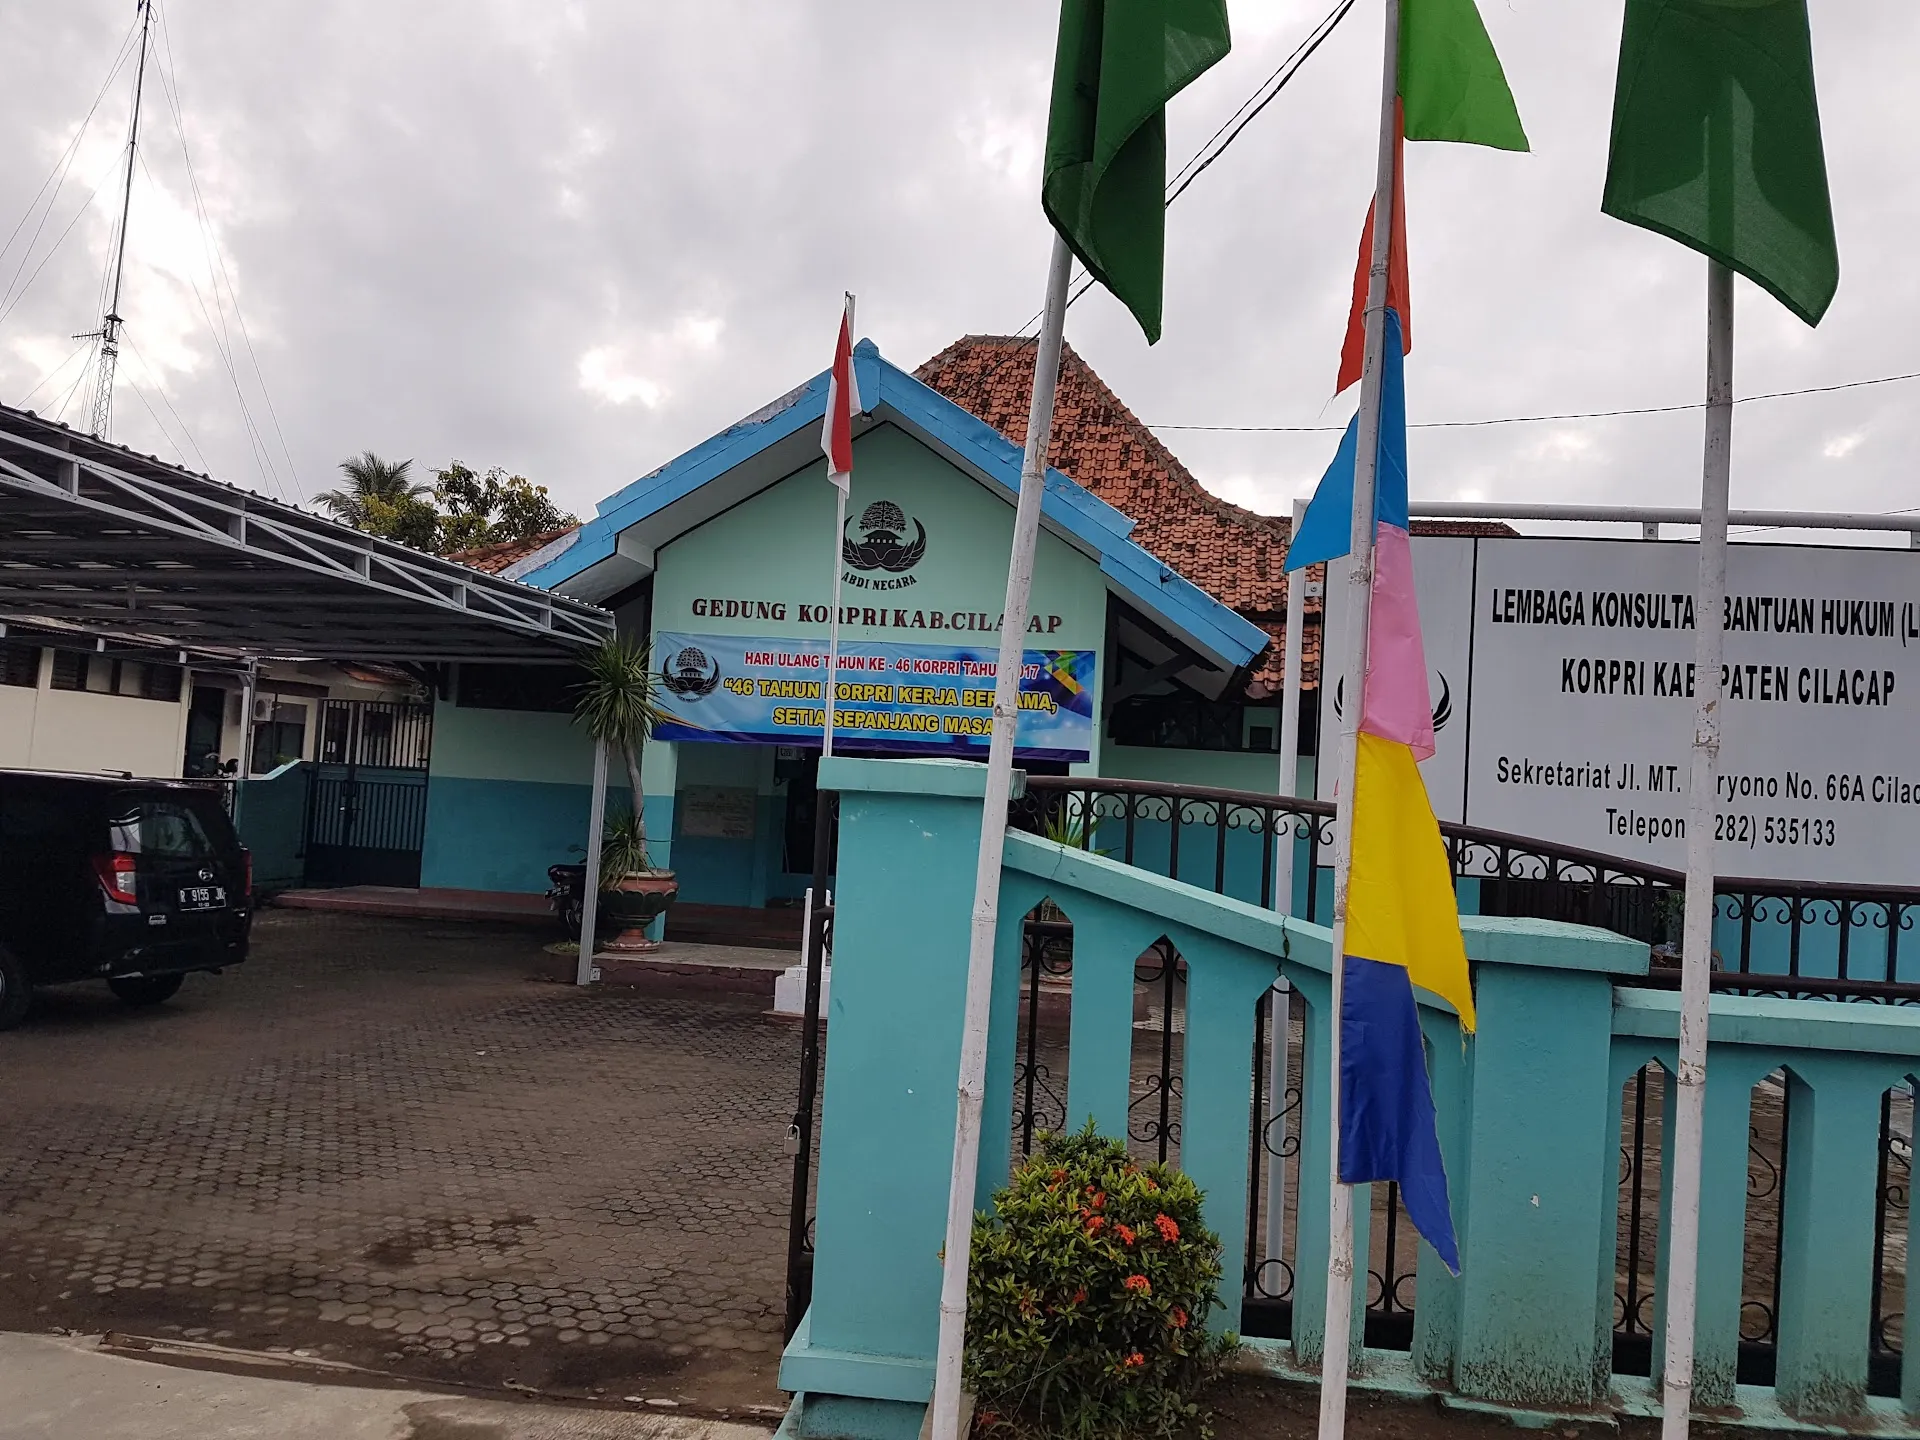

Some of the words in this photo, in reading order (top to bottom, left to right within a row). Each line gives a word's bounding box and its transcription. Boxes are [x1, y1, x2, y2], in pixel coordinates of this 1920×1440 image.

[841, 572, 870, 589] ABDI
[872, 574, 917, 590] NEGARA
[692, 598, 787, 621] GEDUNG
[892, 609, 1063, 633] KAB.CILAAP
[1492, 588, 1585, 626] LEMBAGA
[1821, 599, 1894, 637] HUKUM
[1901, 601, 1920, 647] (L
[745, 652, 773, 666] HARI
[778, 653, 820, 668] ULANG
[824, 655, 865, 670] THUN
[868, 657, 885, 671] KE
[895, 658, 910, 672] 46
[914, 660, 960, 675] KORPRI
[963, 662, 998, 677] TAHU
[758, 679, 820, 699] TAHUN
[898, 687, 958, 706] KERJA
[1561, 658, 1645, 696] KORPRI
[1654, 661, 1789, 702] KABPATEN
[1798, 667, 1895, 706] CILACAP
[773, 707, 826, 726] SETIA
[833, 709, 939, 732] SEPANJANG
[1497, 756, 1611, 789] Sekretariat
[1616, 763, 1641, 791] Jl.
[1648, 764, 1681, 793] MT.
[1785, 771, 1818, 800] No.
[1826, 774, 1866, 802] 66A
[1605, 808, 1686, 844] Telepon
[1764, 816, 1836, 847] 535133
[180, 890, 186, 903] R
